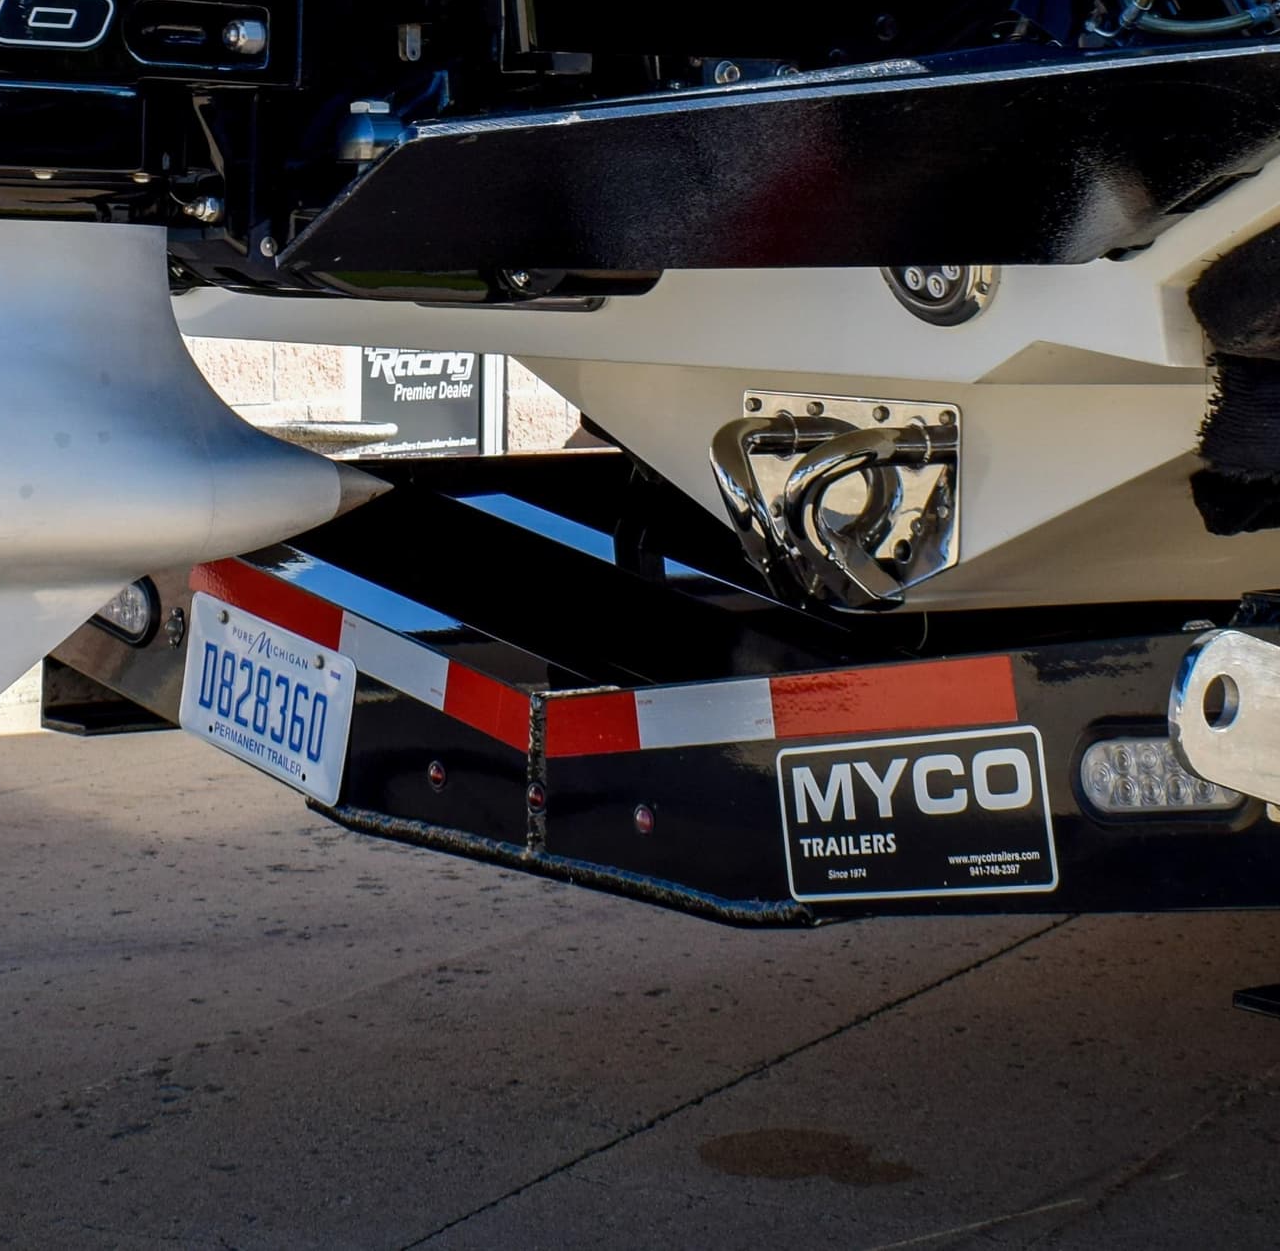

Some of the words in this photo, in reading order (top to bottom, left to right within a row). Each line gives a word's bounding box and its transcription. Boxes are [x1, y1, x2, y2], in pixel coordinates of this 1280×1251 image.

[393, 381, 437, 402] Premier
[438, 380, 473, 399] Dealer
[232, 626, 253, 644] PURE
[247, 631, 309, 670] MICHIGAN
[198, 641, 328, 763] D828360
[214, 721, 266, 758] PERMANENT
[267, 748, 302, 776] TRAILER
[791, 748, 1033, 823] MYCO
[799, 833, 897, 857] TRAILERS
[947, 850, 1040, 865] www.mycotrailers.com
[827, 869, 849, 880] Since
